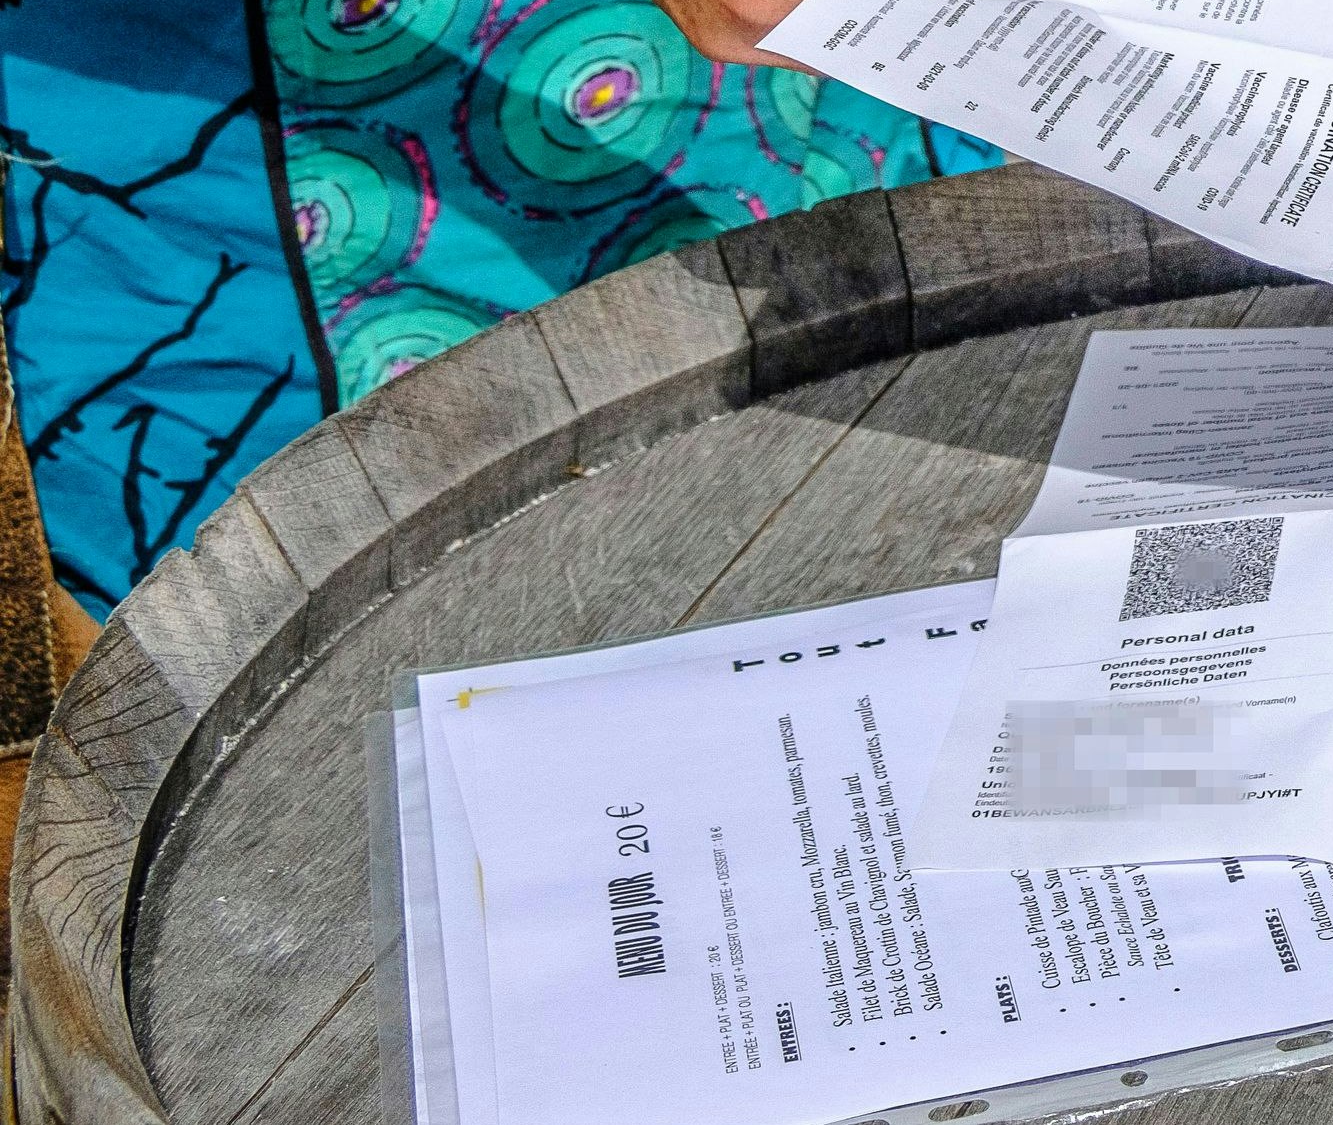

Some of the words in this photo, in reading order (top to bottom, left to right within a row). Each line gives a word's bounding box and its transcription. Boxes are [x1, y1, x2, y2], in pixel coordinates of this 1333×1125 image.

[1287, 79, 1309, 113] Disease
[1283, 114, 1292, 123] or
[1280, 176, 1321, 227] CERTIFICATE
[1120, 630, 1207, 650] Personal
[1212, 624, 1255, 638] data
[1101, 656, 1166, 672] Données
[1169, 644, 1267, 667] personnelles
[1109, 657, 1253, 680] Persoonsgegevens
[1109, 674, 1199, 691] Persönliche
[1203, 669, 1247, 683] Daten
[854, 695, 876, 732] moules.
[778, 713, 804, 762] parmesan.
[866, 733, 887, 779] crevettes,
[788, 763, 807, 805] tomates,
[841, 772, 862, 795] lard.
[875, 781, 894, 806] thon,
[852, 797, 865, 809] au
[792, 806, 820, 867] Mozzarella,
[850, 811, 873, 842] salade
[882, 808, 901, 837] fumé,
[616, 824, 650, 857] 20
[860, 844, 876, 854] et
[832, 844, 851, 879] Blanc.
[608, 872, 664, 911] JOUR
[809, 868, 824, 888] cru,
[837, 880, 855, 900] Vin
[859, 856, 888, 911] Chavignol
[1107, 882, 1121, 893] ou
[1132, 874, 1147, 885] sa
[1134, 887, 1150, 897] et
[1299, 870, 1317, 889] aux
[810, 890, 838, 930] jambon
[845, 901, 859, 914] au
[897, 882, 921, 922] Salade,
[1019, 895, 1045, 934] Pintade
[1051, 890, 1069, 918] Veau
[1078, 886, 1105, 930] Boucher
[1110, 896, 1134, 935] Echalote
[1140, 899, 1159, 927] Veau
[612, 911, 661, 936] DU
[873, 913, 892, 925] de
[1056, 919, 1075, 931] de
[1146, 927, 1165, 940] de
[848, 916, 873, 978] Maquereau
[880, 927, 901, 966] Crottin
[910, 930, 933, 971] Océane
[1031, 936, 1050, 948] de
[1090, 931, 1109, 945] du
[1125, 937, 1144, 966] Sauce
[615, 935, 666, 978] MENU
[822, 939, 844, 987] Italienne
[1038, 951, 1060, 988] Cuisse
[1065, 933, 1091, 983] Escalope
[1098, 947, 1120, 978] Pièce
[1153, 943, 1174, 970] Tête
[711, 972, 728, 1005] DESSERT
[857, 979, 876, 992] de
[885, 968, 905, 981] de
[888, 983, 913, 1017] Brick
[917, 972, 943, 1011] Salade
[827, 989, 852, 1027] Salade
[861, 994, 883, 1022] Filet
[717, 1014, 732, 1033] PLAT
